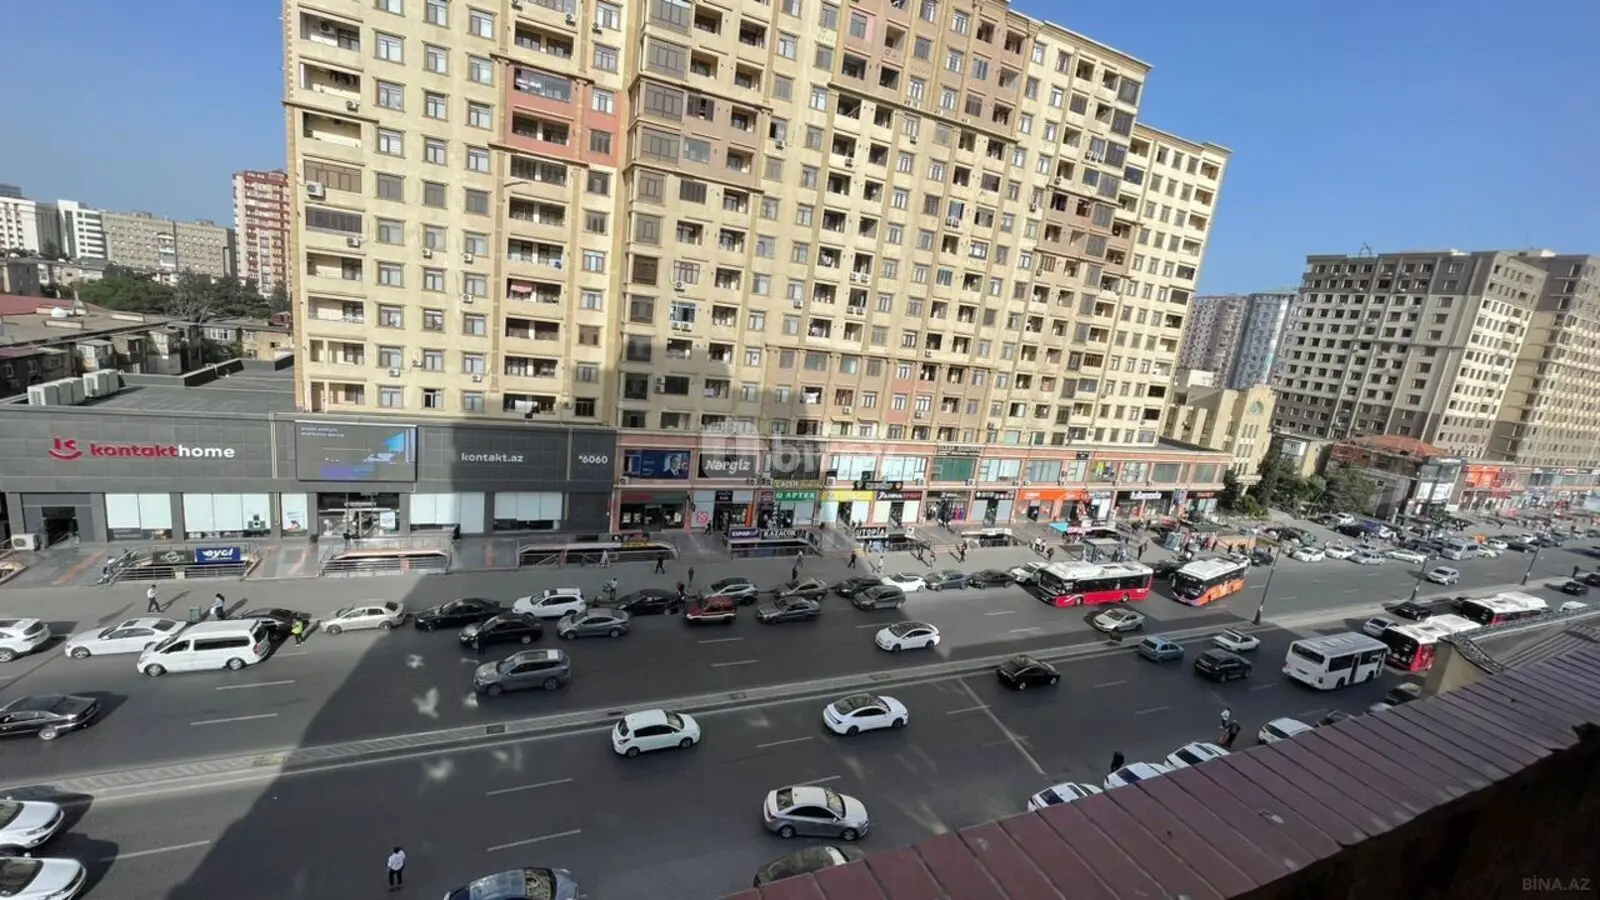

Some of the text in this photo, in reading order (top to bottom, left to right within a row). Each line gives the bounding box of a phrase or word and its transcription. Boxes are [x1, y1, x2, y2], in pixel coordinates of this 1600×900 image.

[90, 443, 235, 458] kontakthome
[460, 452, 524, 462] kontakt.az
[705, 459, 751, 474] Nərgiz
